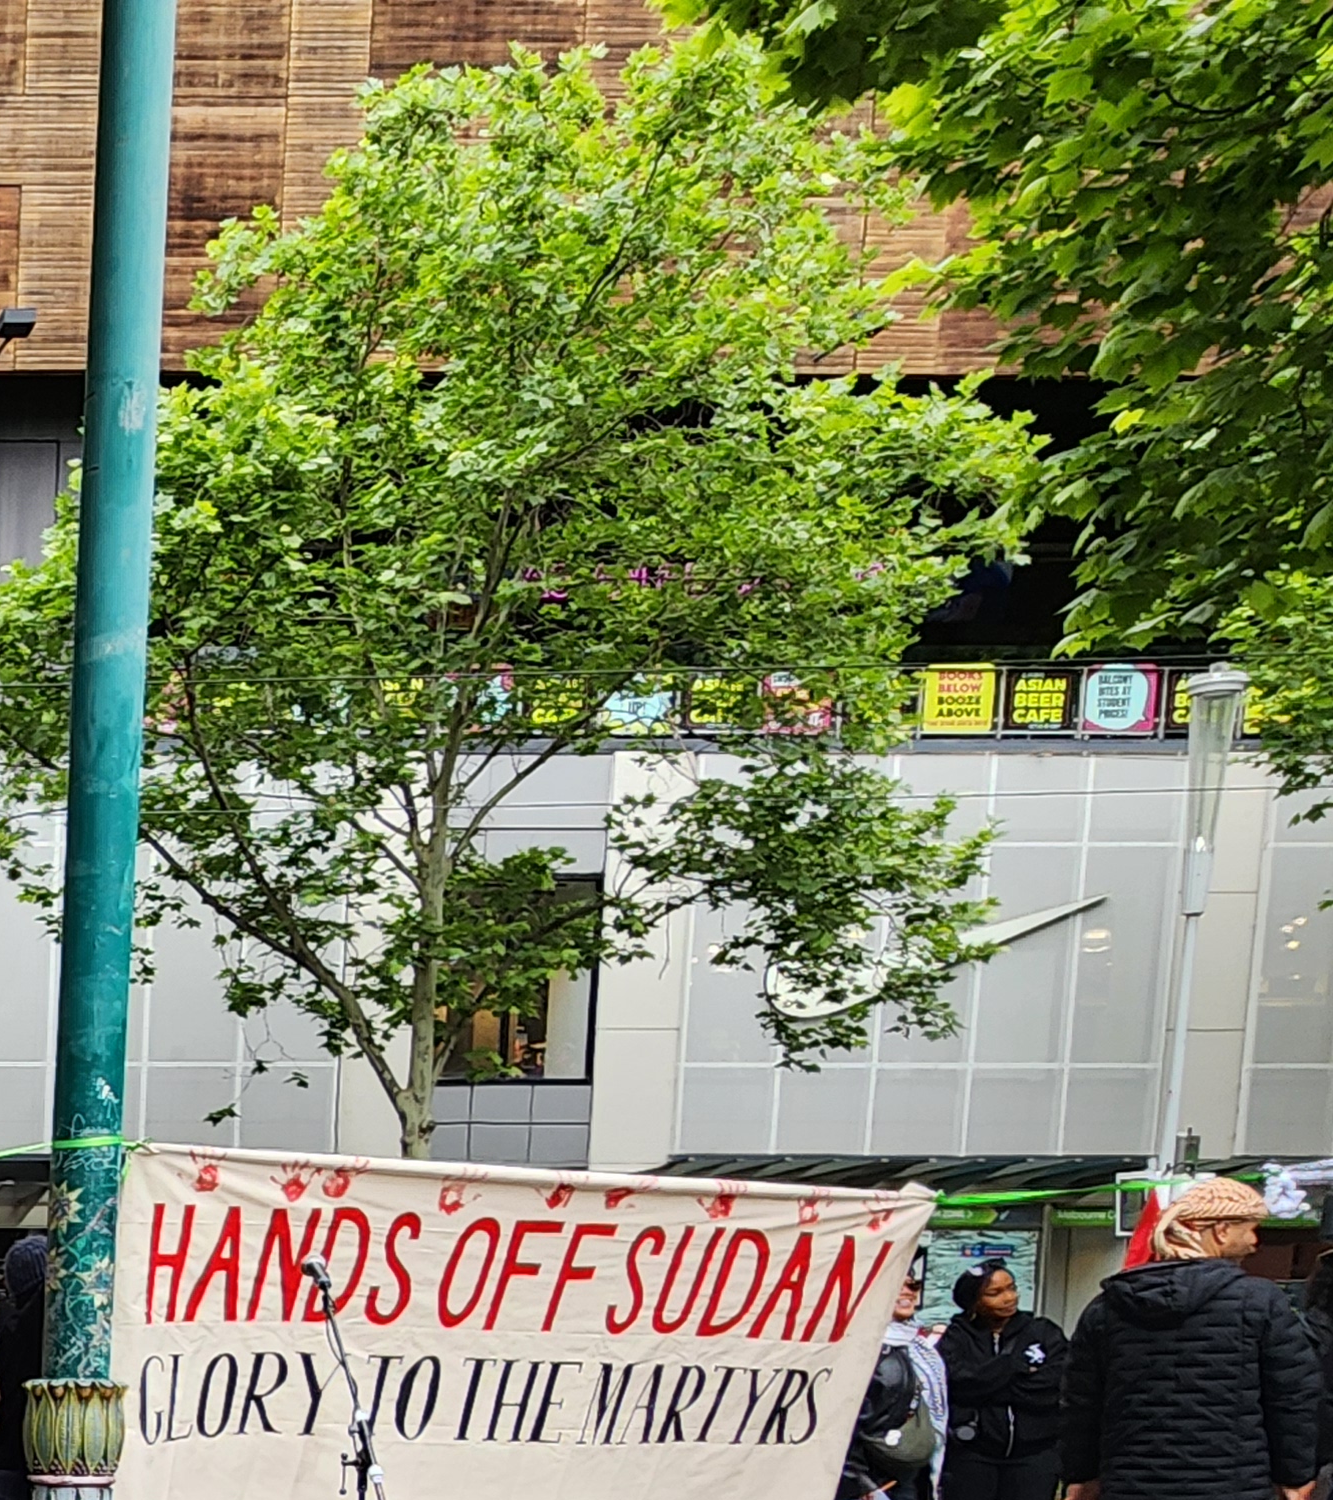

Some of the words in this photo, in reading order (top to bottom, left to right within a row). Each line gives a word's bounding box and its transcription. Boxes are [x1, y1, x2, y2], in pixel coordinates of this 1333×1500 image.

[938, 683, 983, 693] BELOW
[1015, 677, 1067, 691] ASIAN
[937, 695, 982, 706] BOOZE
[1013, 692, 1065, 708] BEER
[935, 707, 981, 718] ABOVE
[1012, 708, 1063, 724] CAFE
[145, 1202, 422, 1325] HANDS
[437, 1216, 619, 1332] OFF
[605, 1224, 894, 1343] SUDAN
[138, 1350, 351, 1446] GLORY
[365, 1354, 442, 1441] TO
[453, 1356, 584, 1444] THE
[576, 1361, 833, 1446] MARTYRS
